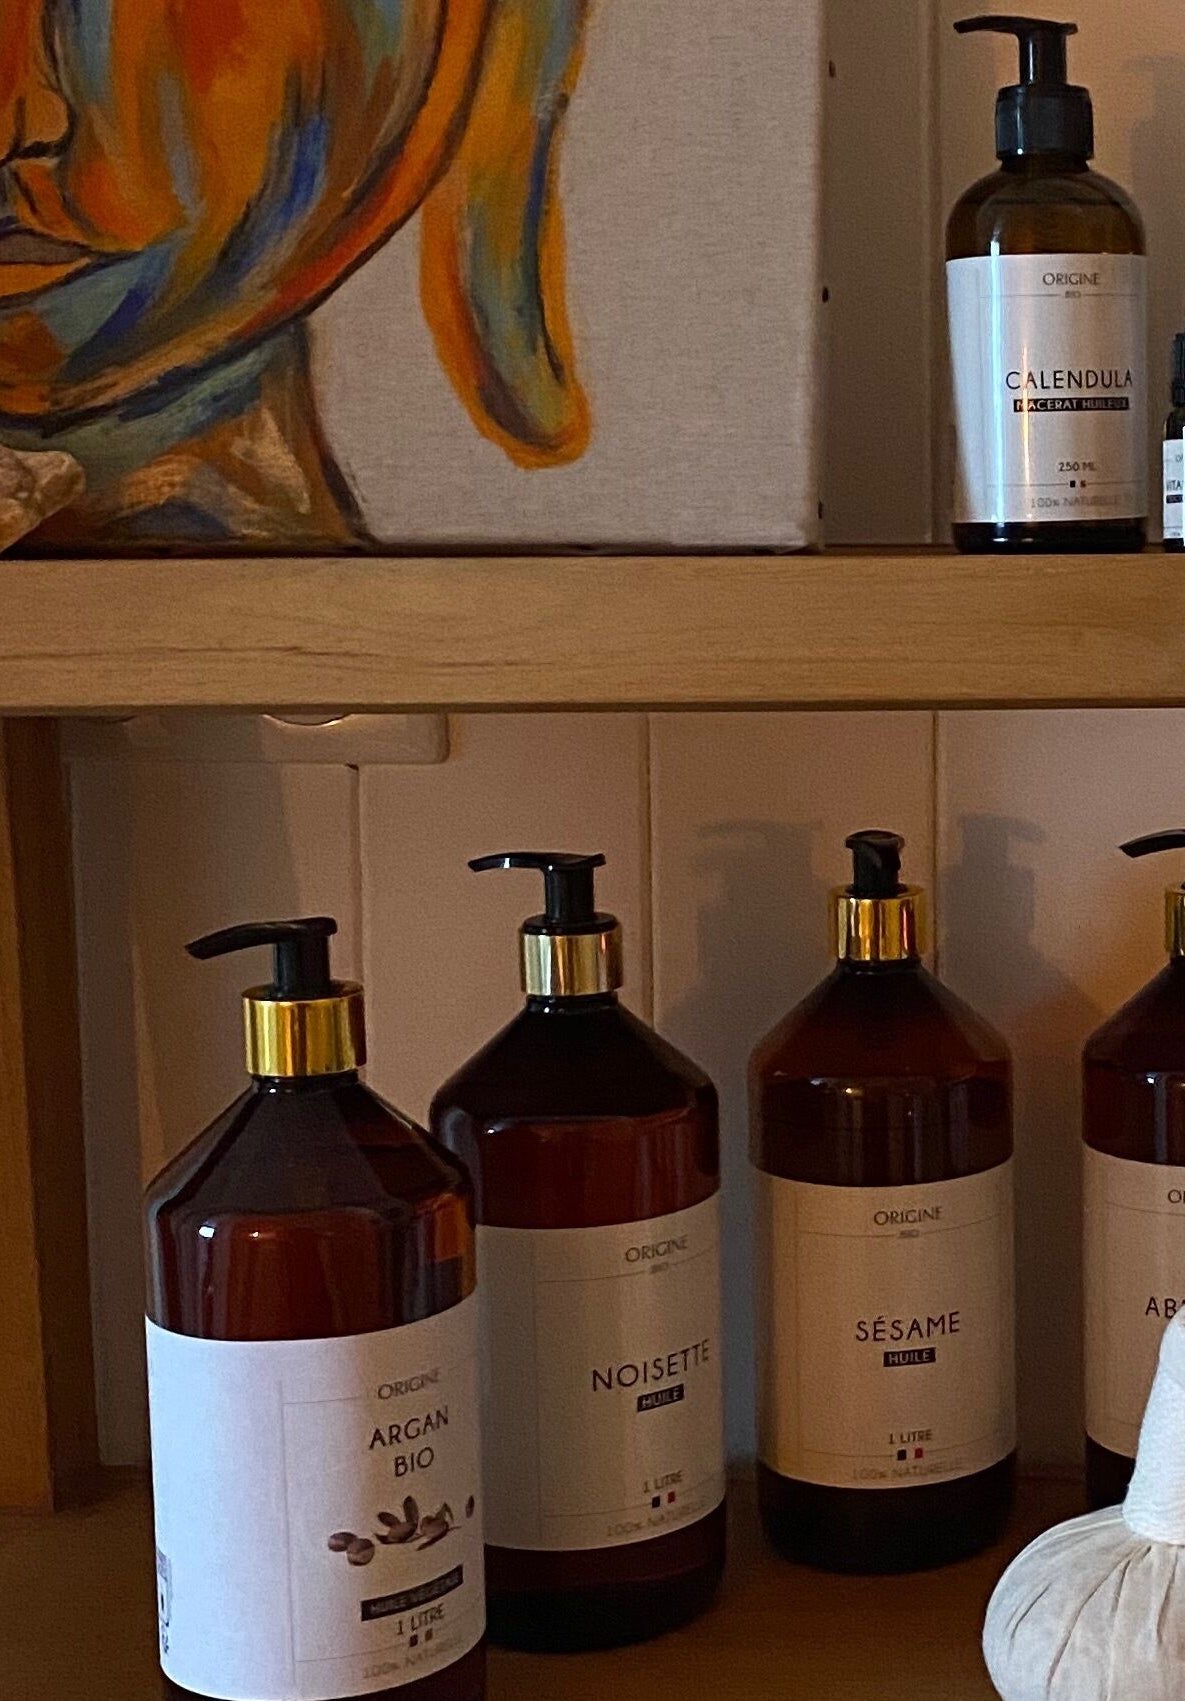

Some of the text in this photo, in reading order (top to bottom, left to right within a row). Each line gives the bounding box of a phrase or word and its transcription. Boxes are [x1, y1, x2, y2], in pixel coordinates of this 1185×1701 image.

[1042, 272, 1101, 287] ORIGINE
[1005, 369, 1133, 390] CALENDULA
[1016, 399, 1077, 411] MACERAT
[1058, 461, 1097, 472] 250 ML
[873, 1206, 943, 1227] ORIGINE
[624, 1234, 690, 1263] ORIGINE
[855, 1311, 961, 1342] SÉSAME
[591, 1338, 711, 1393] NOISETTE
[888, 1350, 931, 1365] HUILE
[377, 1367, 441, 1400] ORIGINE
[640, 1386, 682, 1409] HUILE
[369, 1405, 449, 1450] ARGAN
[899, 1428, 933, 1444] LITRE
[393, 1446, 436, 1477] BIO
[410, 1601, 446, 1632] LITRE
